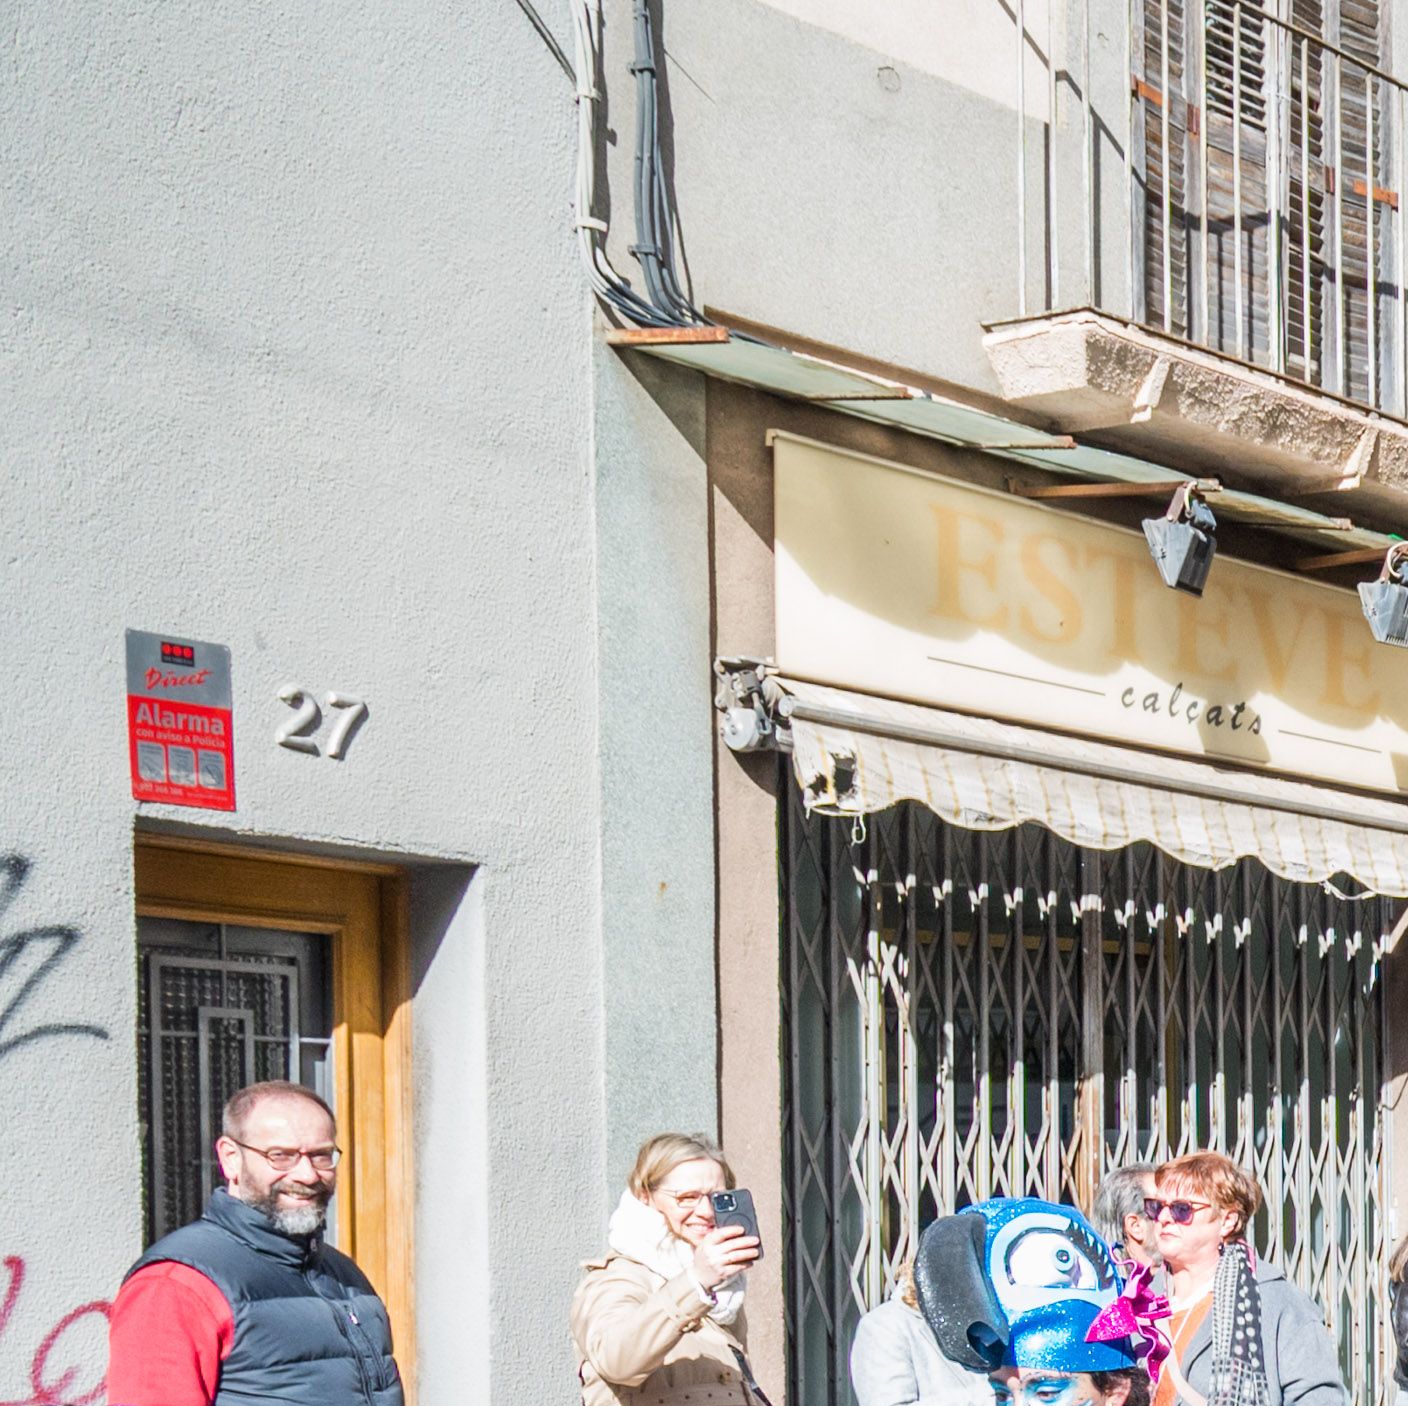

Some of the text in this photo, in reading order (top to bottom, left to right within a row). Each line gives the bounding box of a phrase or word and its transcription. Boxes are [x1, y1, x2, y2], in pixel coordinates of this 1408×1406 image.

[928, 502, 1382, 710] ESTEVE
[144, 666, 213, 690] Direct
[136, 702, 225, 735] Alarma
[275, 683, 368, 761] 27
[1120, 682, 1263, 736] calçats
[136, 728, 153, 739] con
[155, 731, 182, 743] aviso
[184, 735, 190, 743] a
